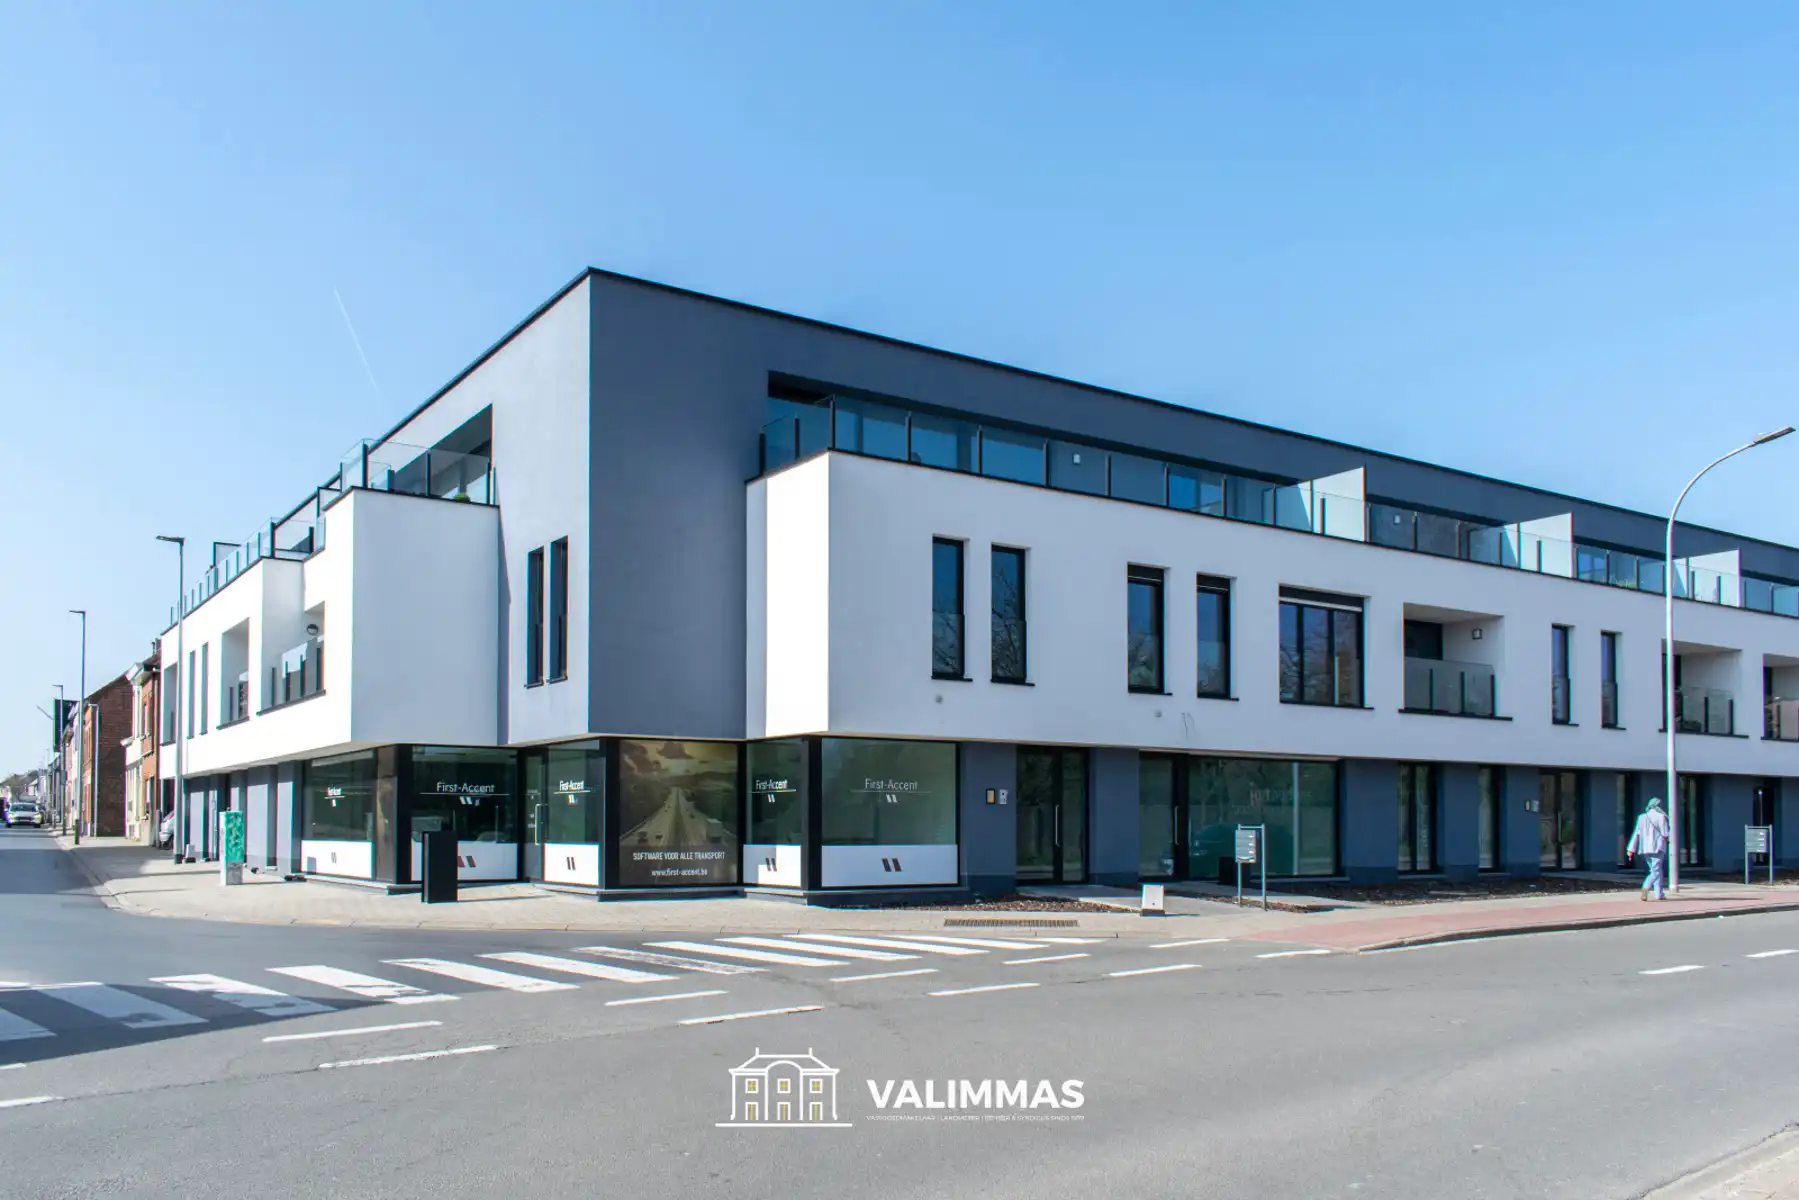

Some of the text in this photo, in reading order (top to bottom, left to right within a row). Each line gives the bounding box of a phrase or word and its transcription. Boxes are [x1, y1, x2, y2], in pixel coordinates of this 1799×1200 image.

[436, 780, 496, 793] First-Accent
[865, 777, 918, 790] First-Accent
[632, 851, 725, 861] SOFTWARE VOOR ALLE TRANSPORT
